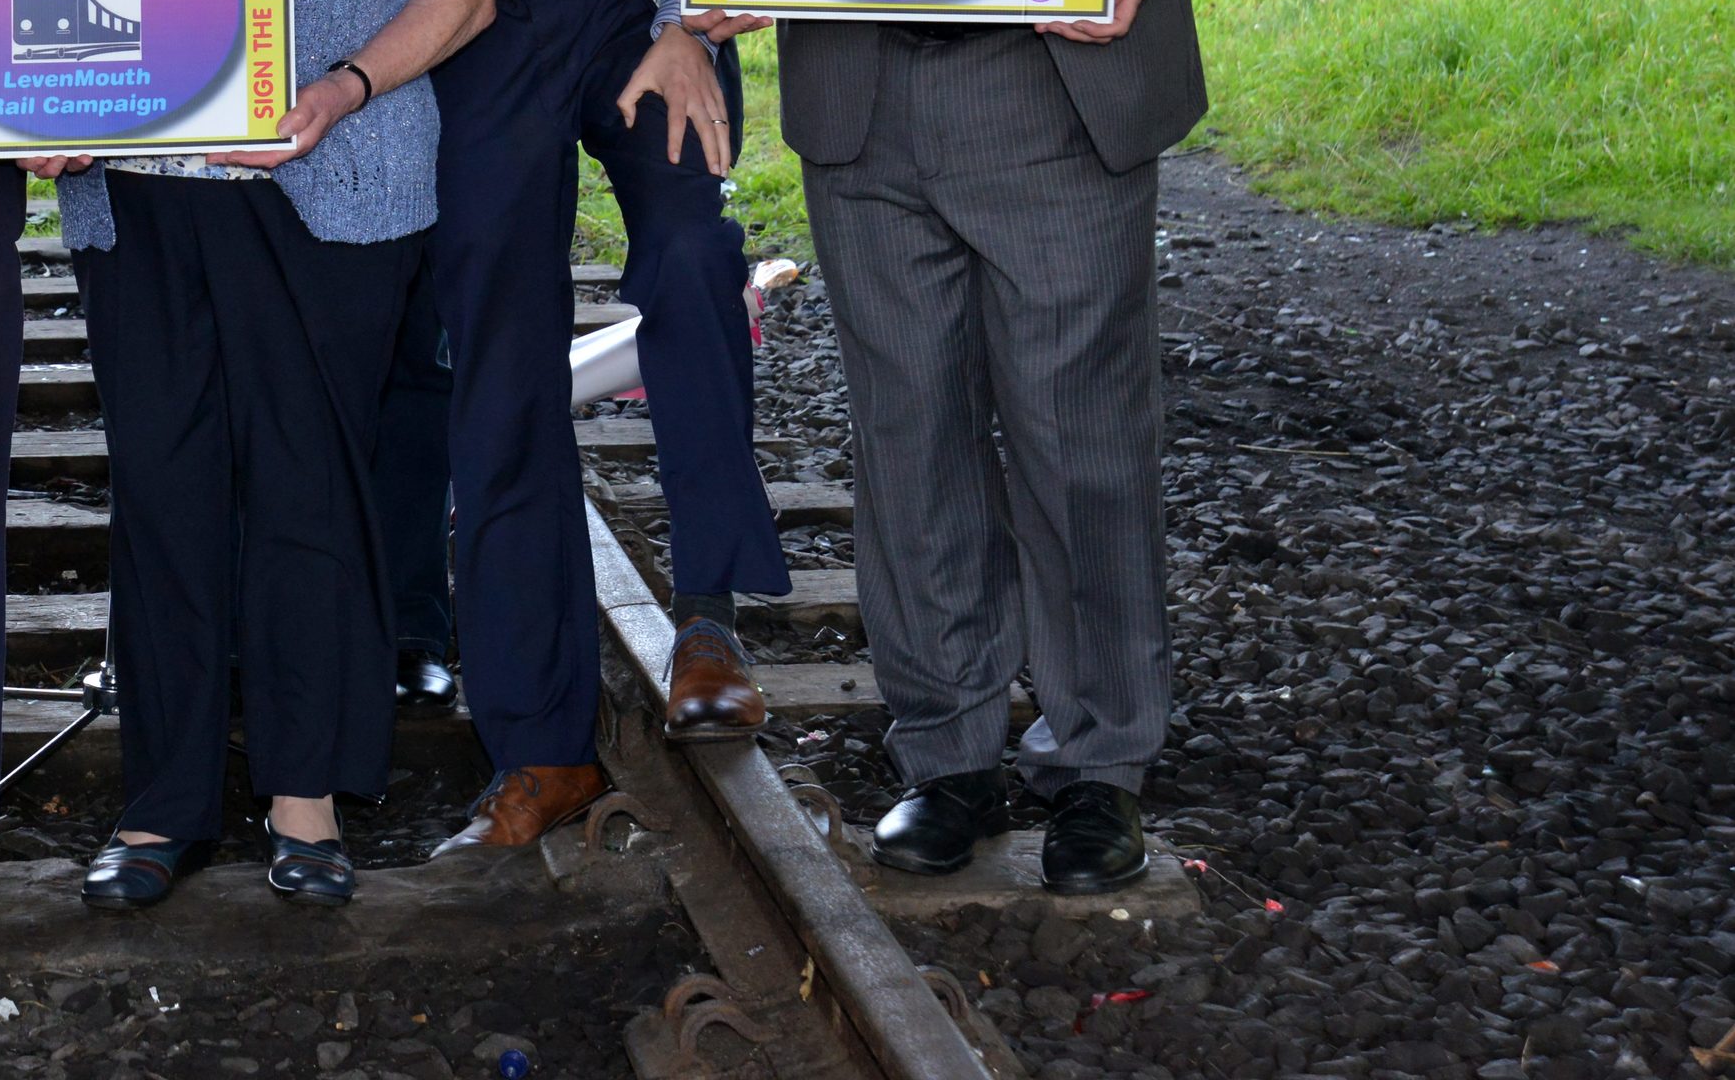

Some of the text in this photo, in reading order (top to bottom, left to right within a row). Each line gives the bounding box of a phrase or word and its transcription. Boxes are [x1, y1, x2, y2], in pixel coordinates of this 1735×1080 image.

[253, 8, 273, 53] THE
[3, 68, 151, 89] LevenMouth
[253, 60, 274, 119] SIGN
[43, 95, 167, 117] Campaign
